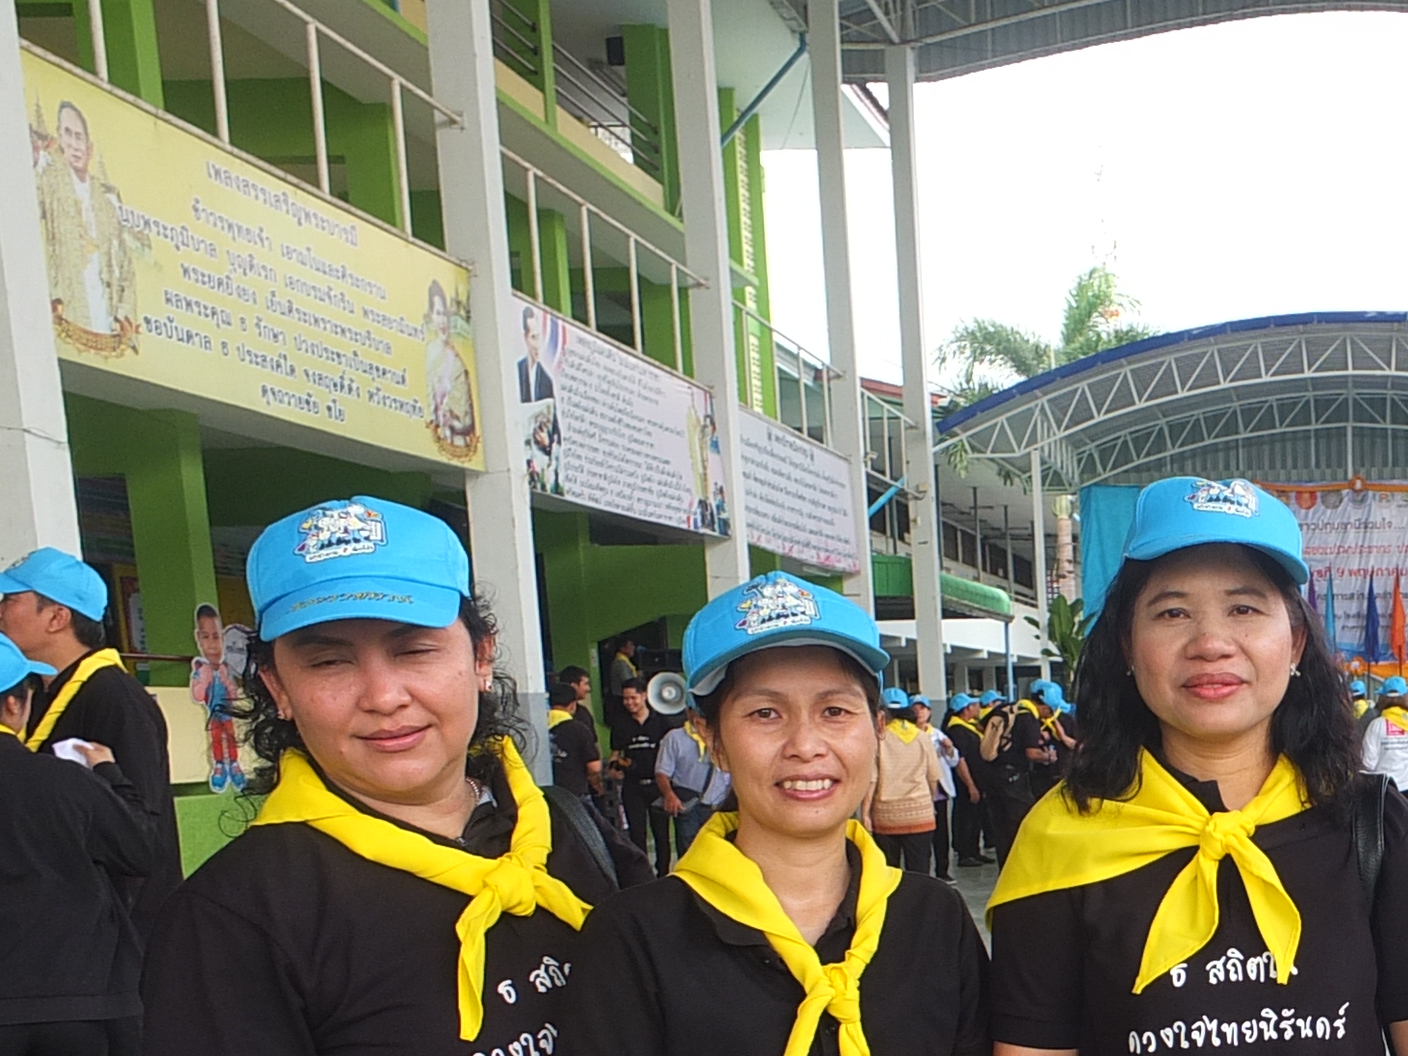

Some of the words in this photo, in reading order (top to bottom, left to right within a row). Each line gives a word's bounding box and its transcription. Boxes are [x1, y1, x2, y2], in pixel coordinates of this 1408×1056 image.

[143, 315, 212, 351] ขอบันดาล
[221, 341, 229, 357] ธ
[1169, 963, 1188, 987] ธ
[1206, 948, 1298, 985] สถิตใ
[497, 979, 517, 1004] ธ
[1128, 1001, 1350, 1055] ดวงใจไทยนิรันดร์
